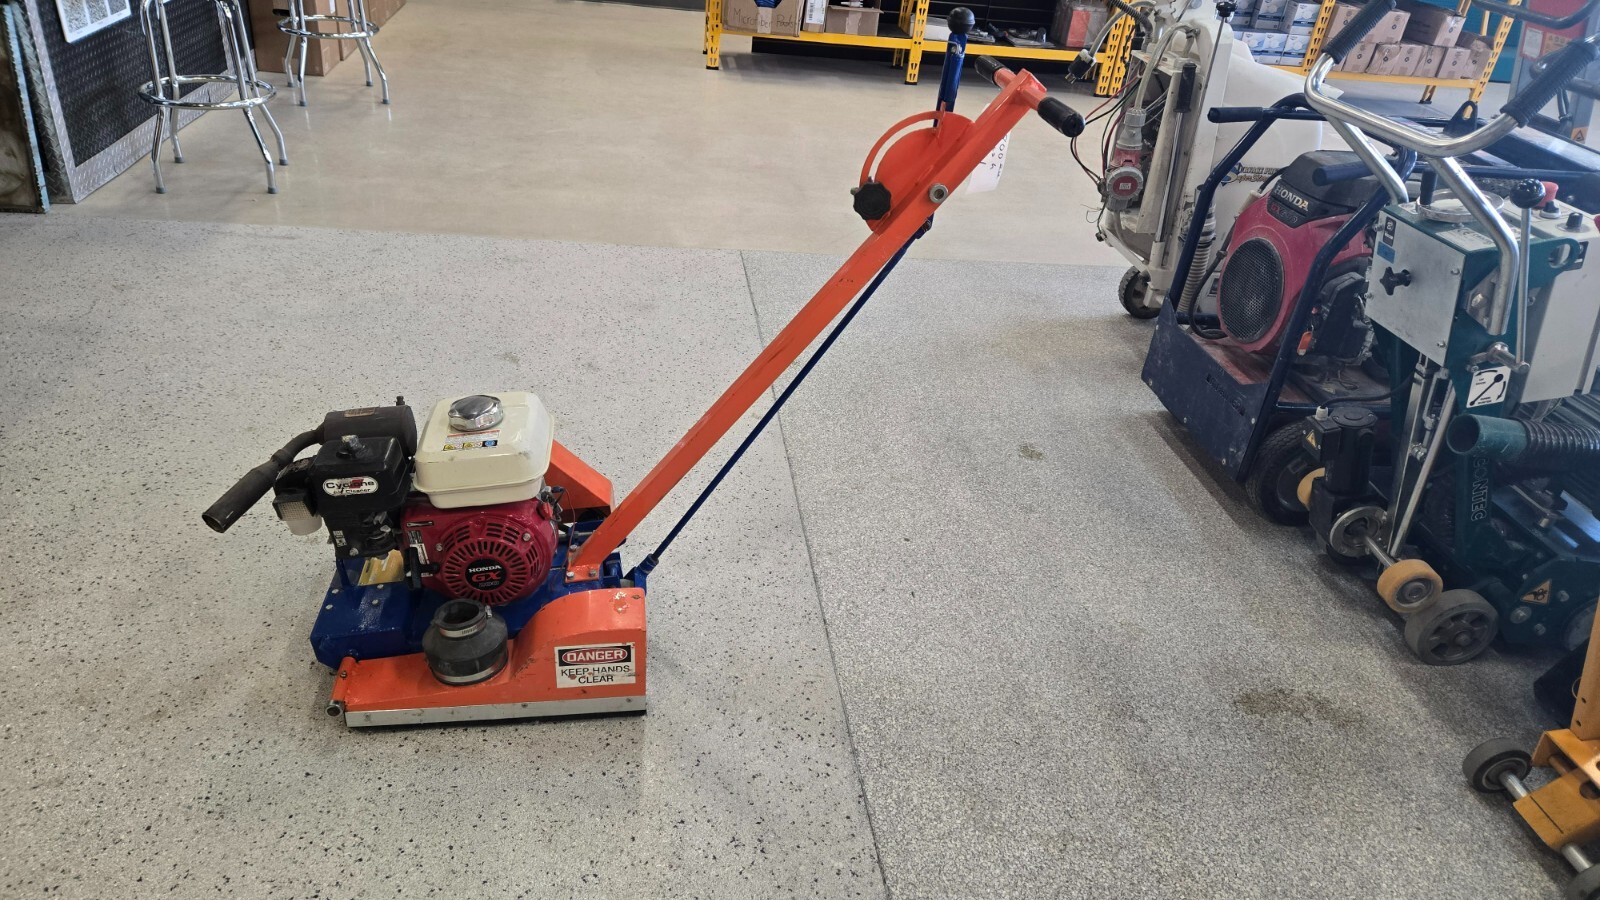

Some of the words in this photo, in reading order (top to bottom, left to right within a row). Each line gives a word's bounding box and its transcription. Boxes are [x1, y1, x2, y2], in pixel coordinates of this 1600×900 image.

[1274, 185, 1309, 212] HONDA
[325, 481, 375, 489] Cyclone
[472, 571, 501, 582] GX
[566, 650, 623, 662] DANGER
[561, 667, 589, 677] KEEP
[592, 665, 630, 674] HANDS
[578, 675, 614, 684] CLEAR
